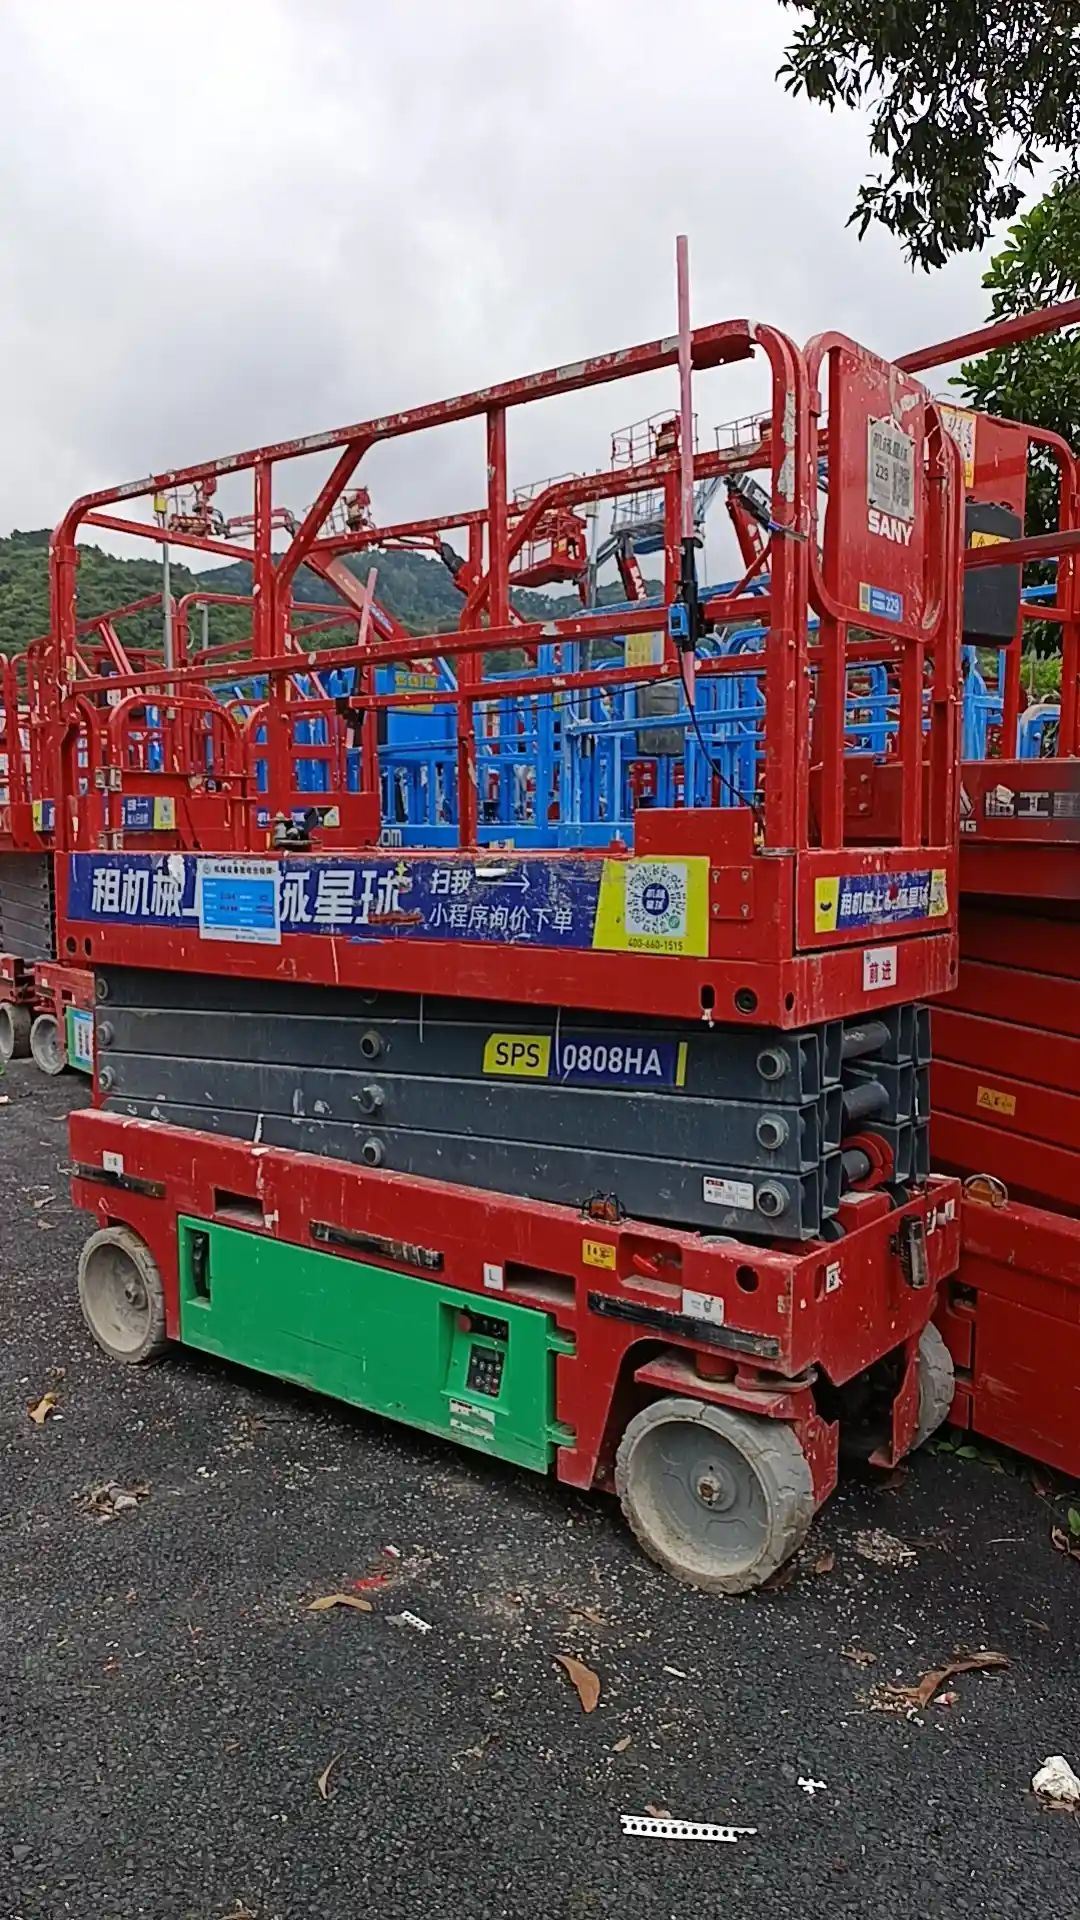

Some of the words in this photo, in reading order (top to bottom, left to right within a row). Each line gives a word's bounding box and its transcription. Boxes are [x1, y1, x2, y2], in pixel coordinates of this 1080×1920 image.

[868, 509, 913, 547] SANY
[430, 869, 472, 895] 扫我
[429, 903, 573, 935] 小程序询价下单
[628, 937, 684, 951] 400-660-1515
[495, 1042, 541, 1068] SPS
[562, 1044, 663, 1077] 0808HA
